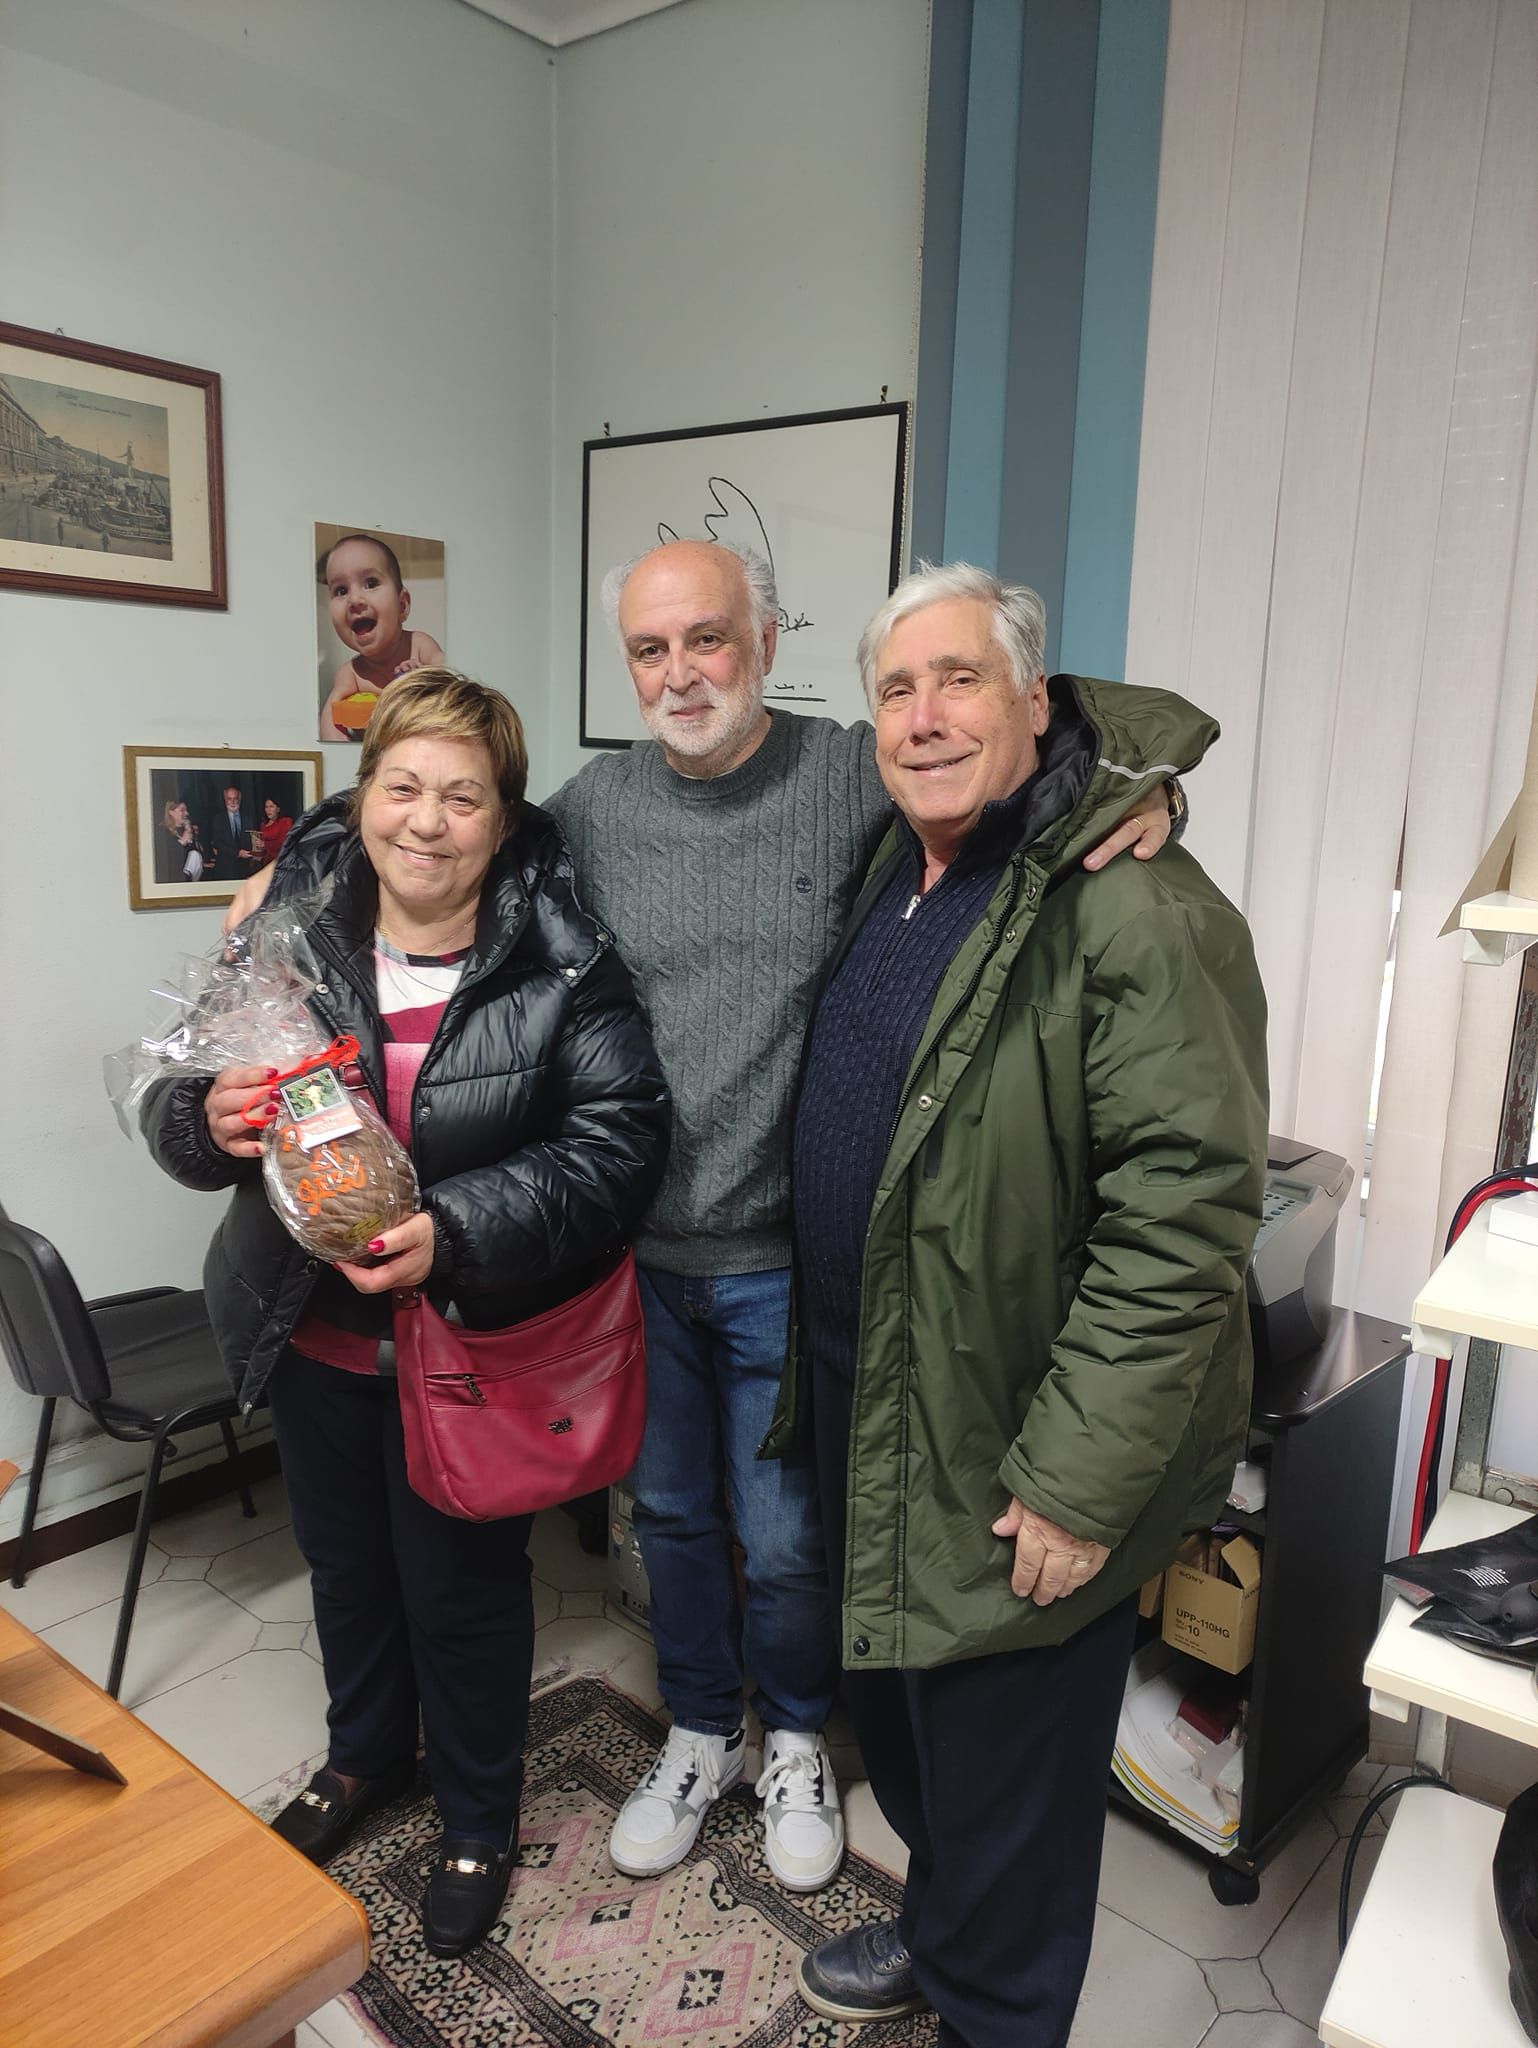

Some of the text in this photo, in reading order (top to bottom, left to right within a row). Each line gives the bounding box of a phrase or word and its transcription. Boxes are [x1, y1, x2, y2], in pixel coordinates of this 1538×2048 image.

[1178, 1570, 1205, 1585] SONY
[1176, 1608, 1230, 1639] UPP-110HG
[1187, 1625, 1200, 1637] 10
